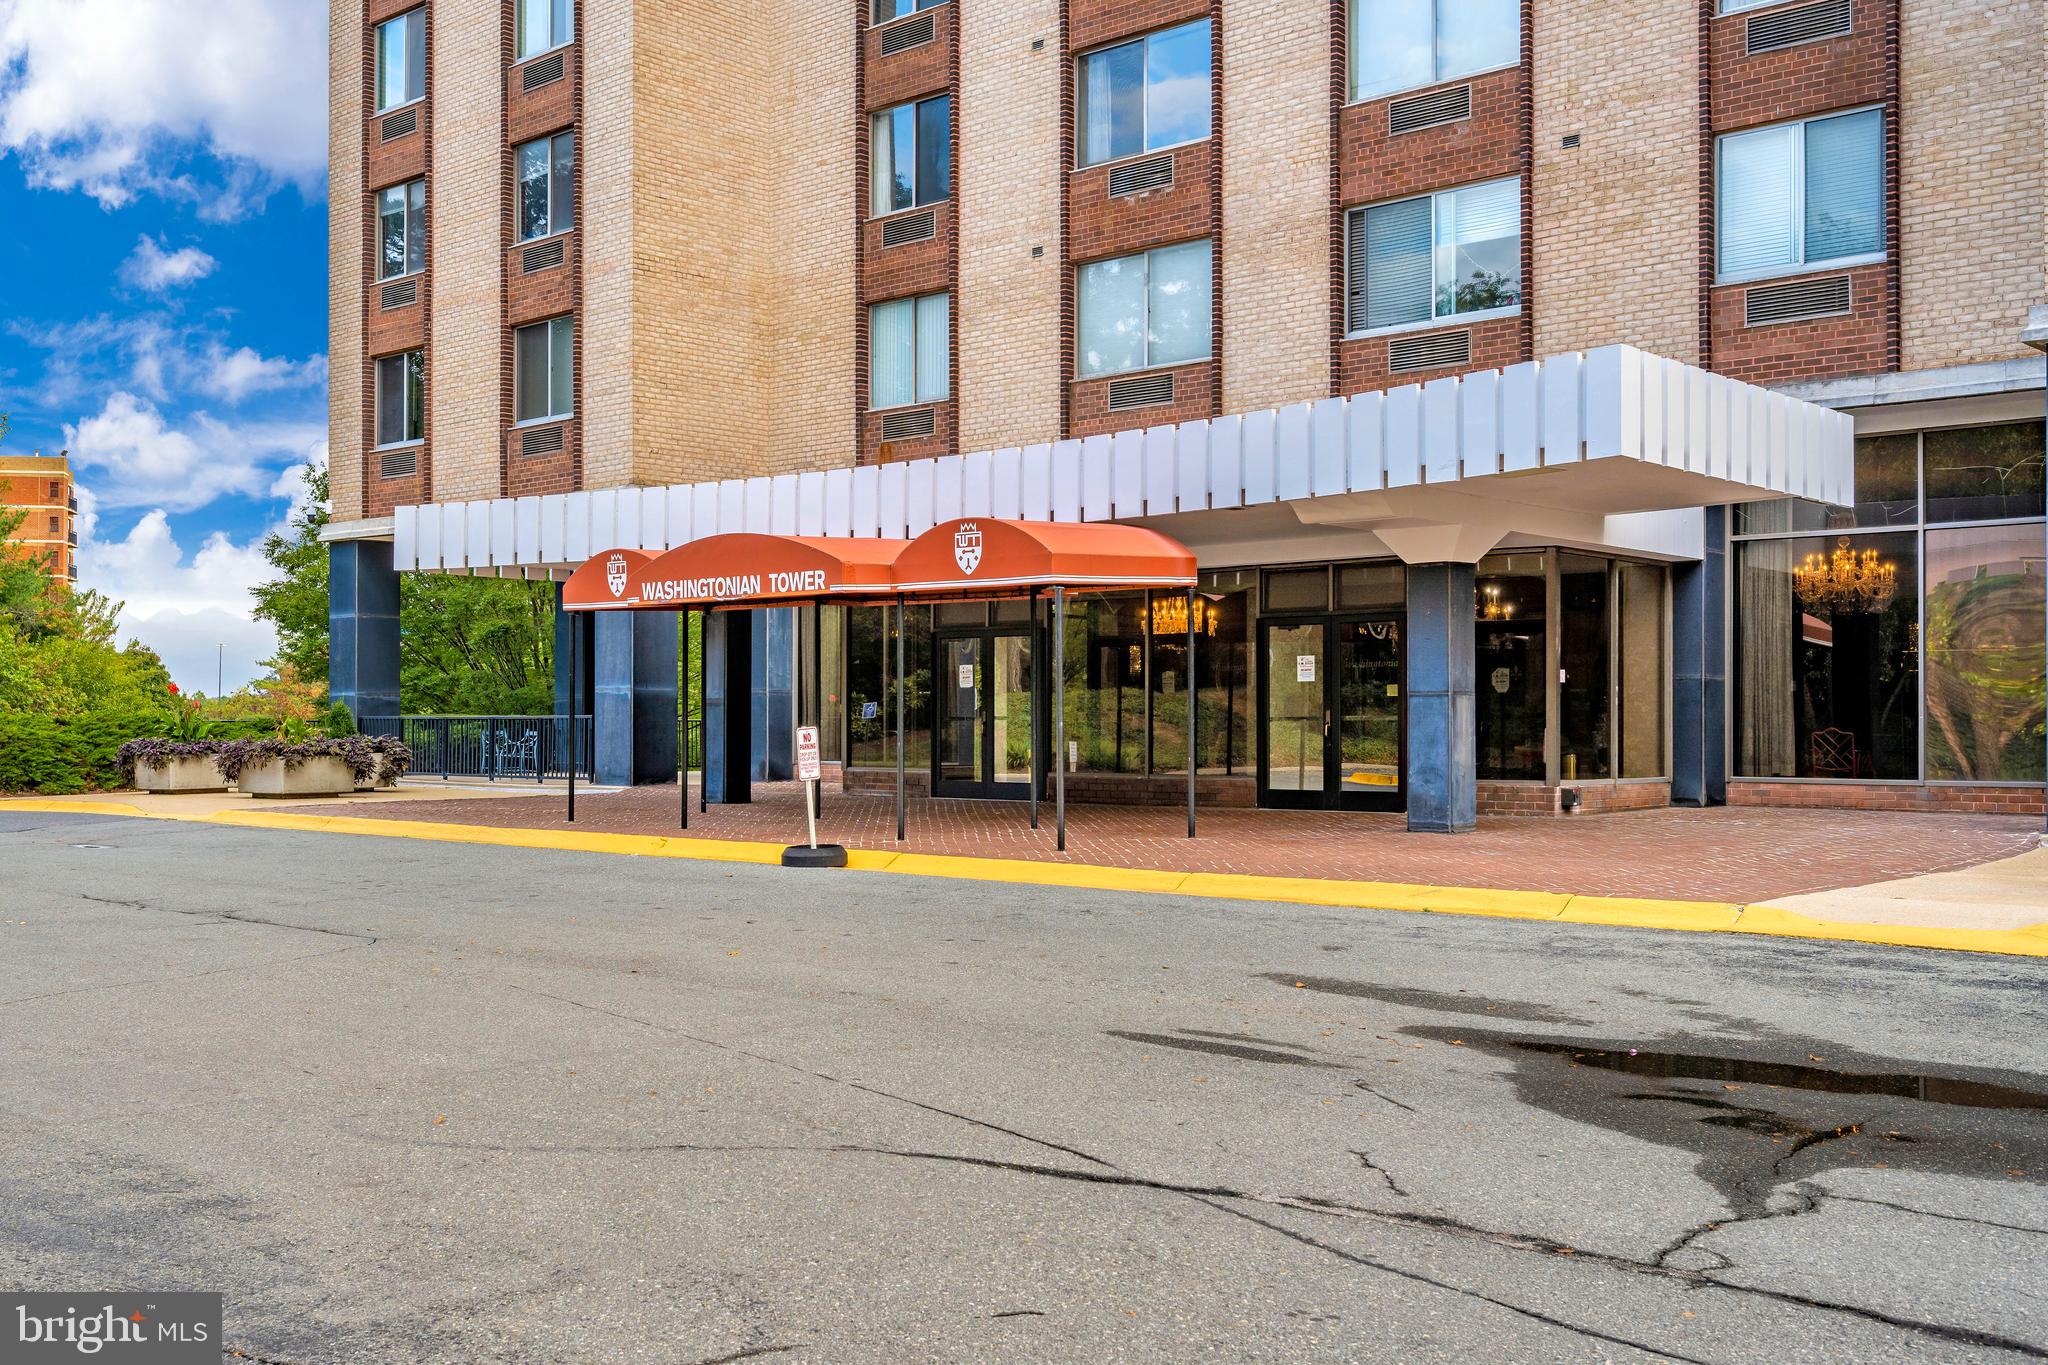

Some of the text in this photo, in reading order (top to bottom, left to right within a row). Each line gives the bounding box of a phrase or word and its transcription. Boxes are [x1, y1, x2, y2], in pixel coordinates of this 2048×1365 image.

[641, 570, 826, 601] WASHINGTONIAN TOWER
[803, 733, 812, 743] NO
